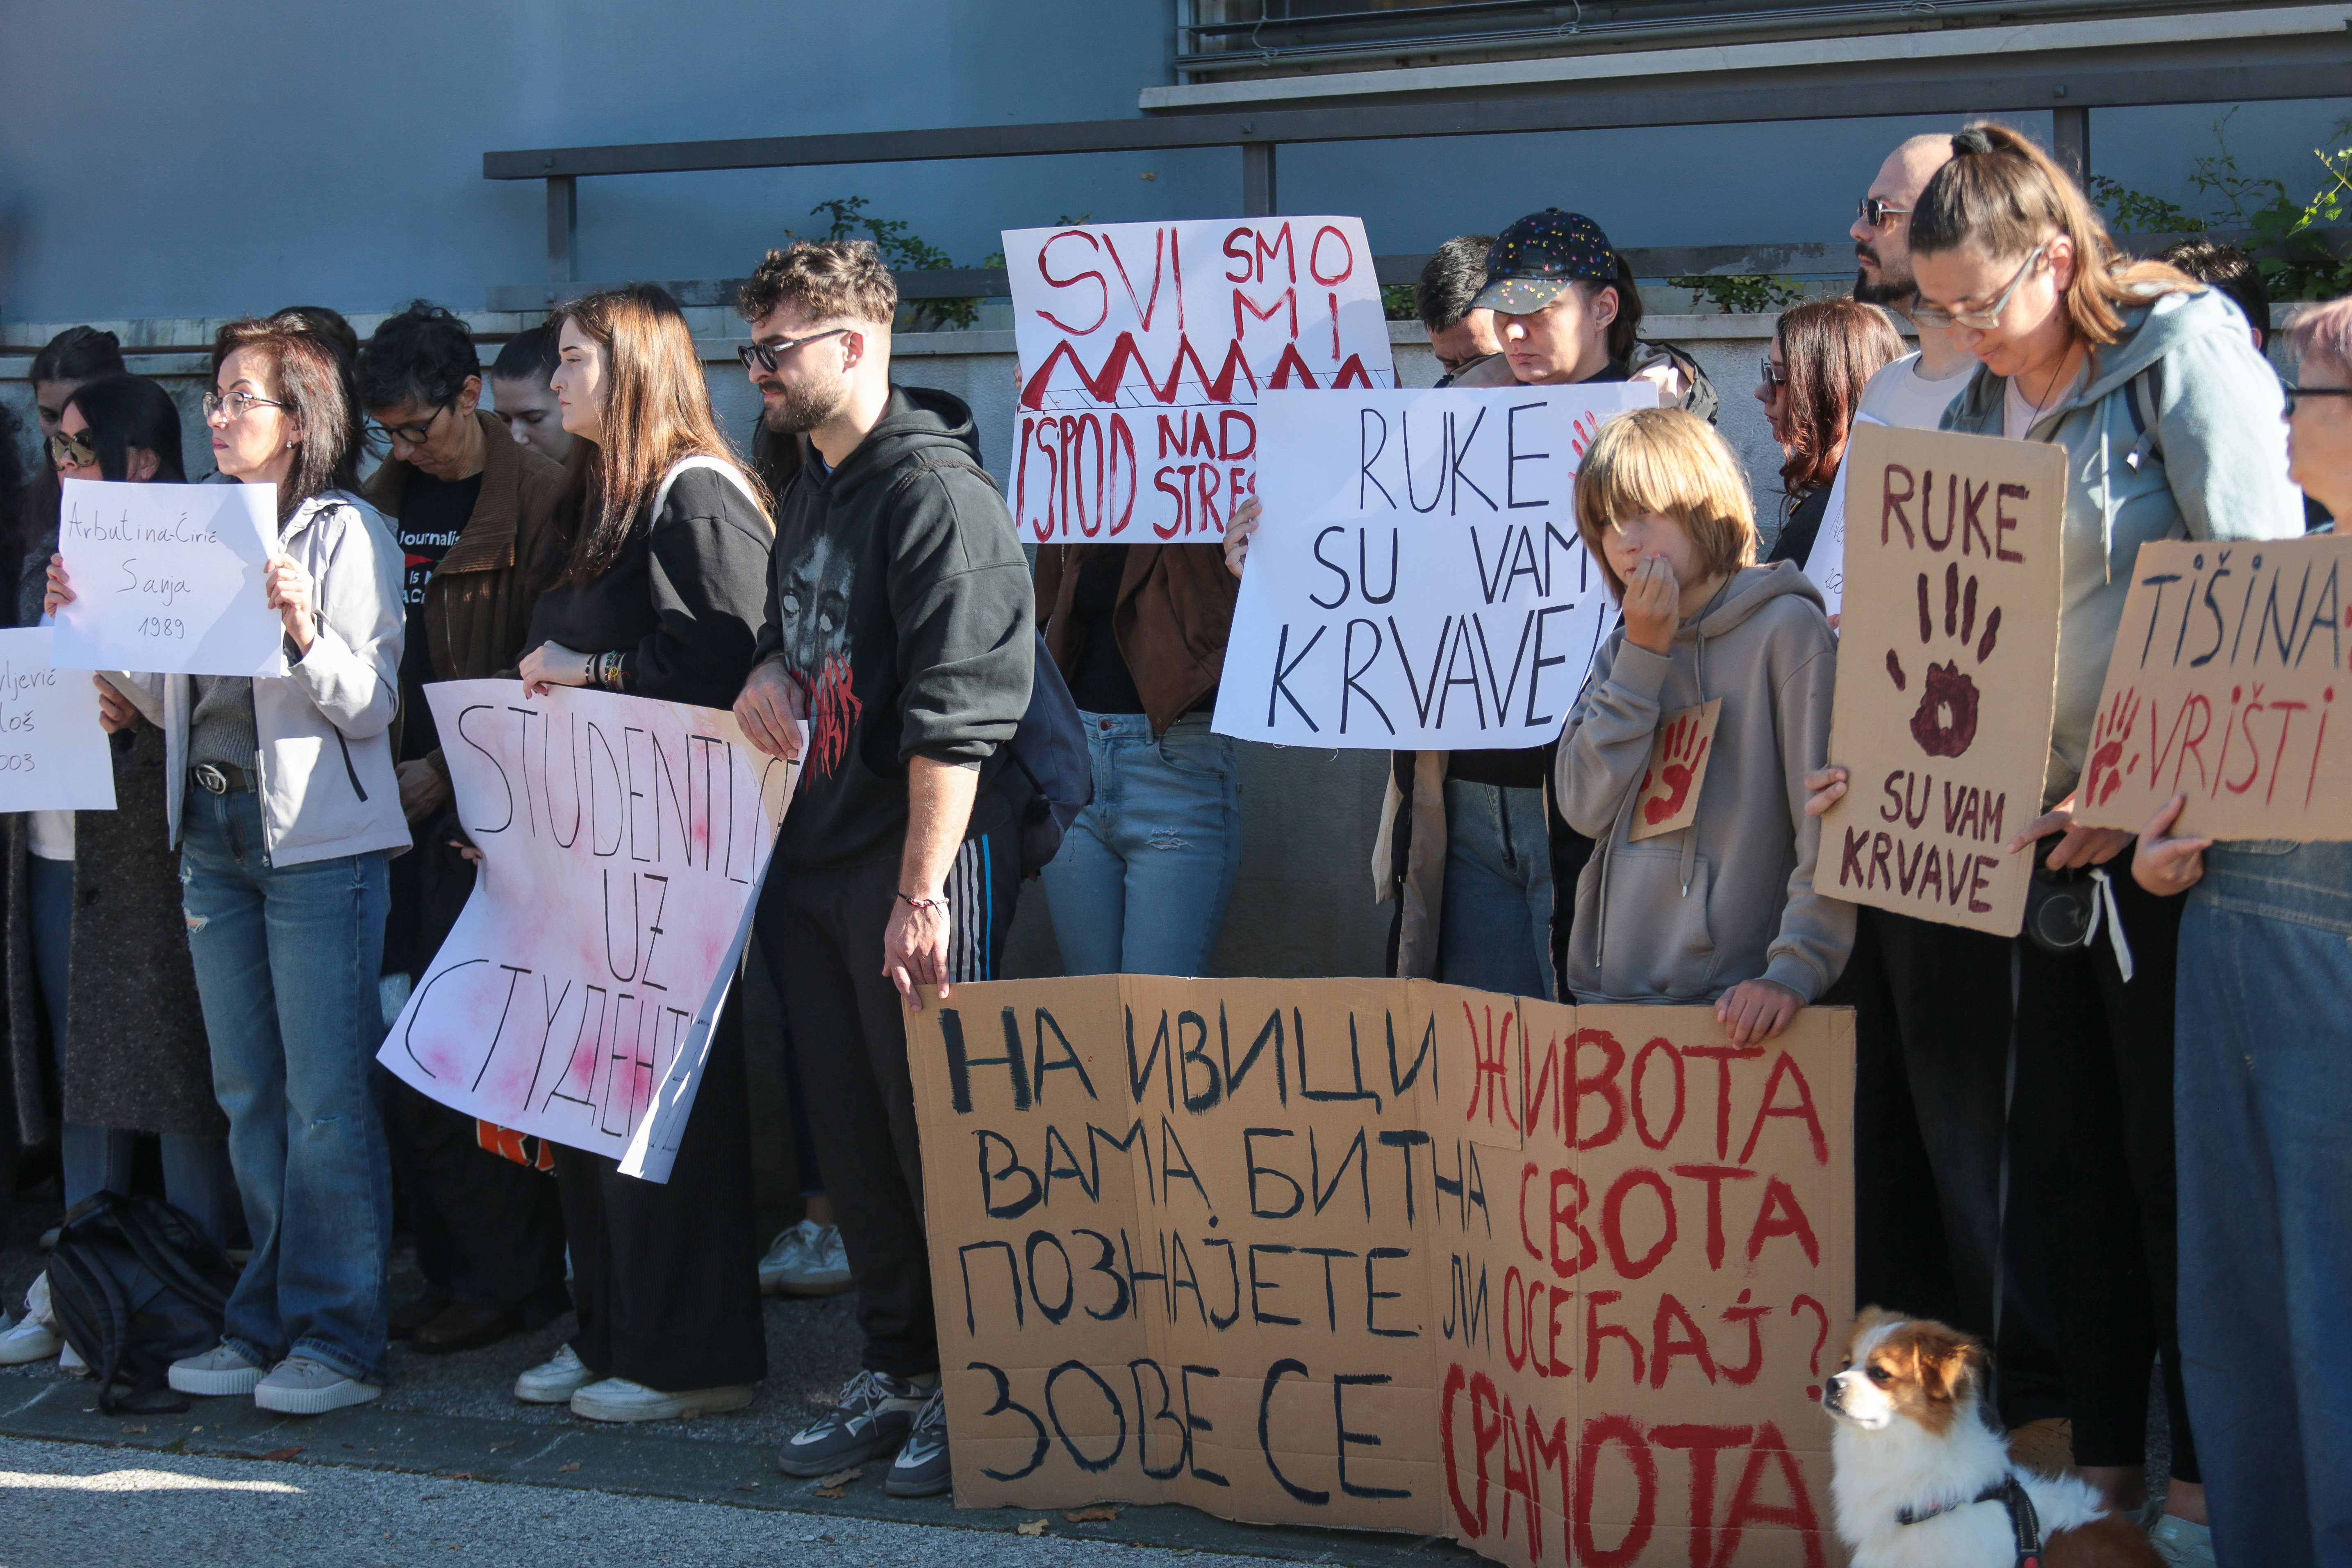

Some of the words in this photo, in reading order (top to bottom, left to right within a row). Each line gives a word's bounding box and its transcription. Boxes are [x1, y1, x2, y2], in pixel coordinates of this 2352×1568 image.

[1036, 227, 1184, 336] SVI
[1223, 221, 1353, 287] SMO
[1233, 285, 1340, 364] MI
[1014, 412, 1137, 542] ISPOD
[1153, 464, 1256, 540] STRE
[1360, 402, 1549, 516] RUKE
[68, 501, 217, 544] Arbutina-Ćirić
[1881, 463, 2029, 564] RUKE
[116, 558, 192, 607] Sanja
[1309, 526, 1398, 610] SU
[1470, 521, 1587, 605] VAM
[138, 617, 185, 639] 1989
[1880, 770, 1931, 830] SU
[1943, 780, 2006, 844] VAM
[1839, 826, 1999, 913] KRVAVE
[604, 868, 669, 992] UZ
[405, 959, 694, 1137] СТУДЕНТ
[938, 1006, 1099, 1115] НА
[1125, 999, 1439, 1116] ИВИЦИ
[1462, 1000, 1828, 1165] ЖИВОТА
[1244, 1125, 1492, 1240] БИТНА
[1519, 1162, 1820, 1279] СВОТА
[1442, 1251, 1491, 1357] ЛИ
[967, 1358, 1230, 1488] ЗОВЕ
[1258, 1358, 1412, 1506] СЕ
[1440, 1362, 1827, 1568] СРАМОТА
